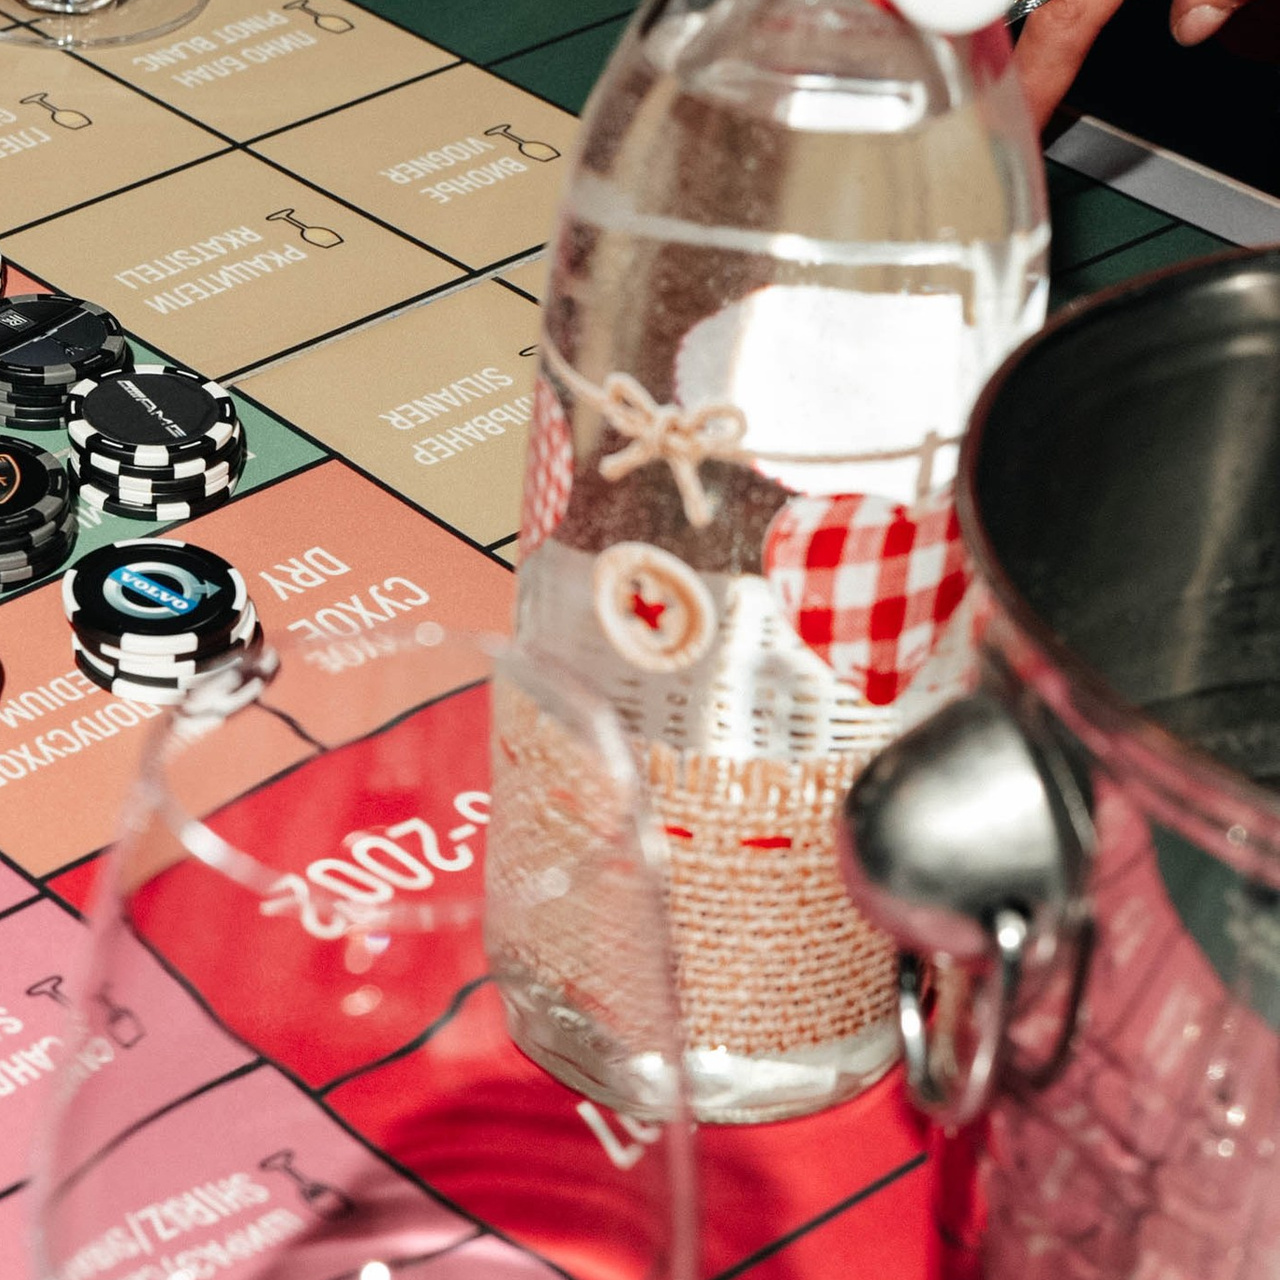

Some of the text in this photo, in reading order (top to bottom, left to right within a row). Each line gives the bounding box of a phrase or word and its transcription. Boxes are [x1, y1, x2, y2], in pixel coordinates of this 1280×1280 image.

[131, 9, 291, 74] PINOT BLANC
[170, 29, 320, 91] ПИНО БЛАН
[379, 134, 495, 186] VIOGNER
[420, 155, 528, 211] ВИОНЬЕ
[111, 223, 266, 292] RKATSITELI
[143, 242, 310, 317] РКАЦИТЕЛИ
[378, 366, 514, 431] SILVANER
[412, 392, 535, 466] ИЛЬВАНЕР
[120, 571, 191, 611] VOLVO
[258, 546, 352, 603] DRY
[286, 576, 432, 641] СУХОЕ
